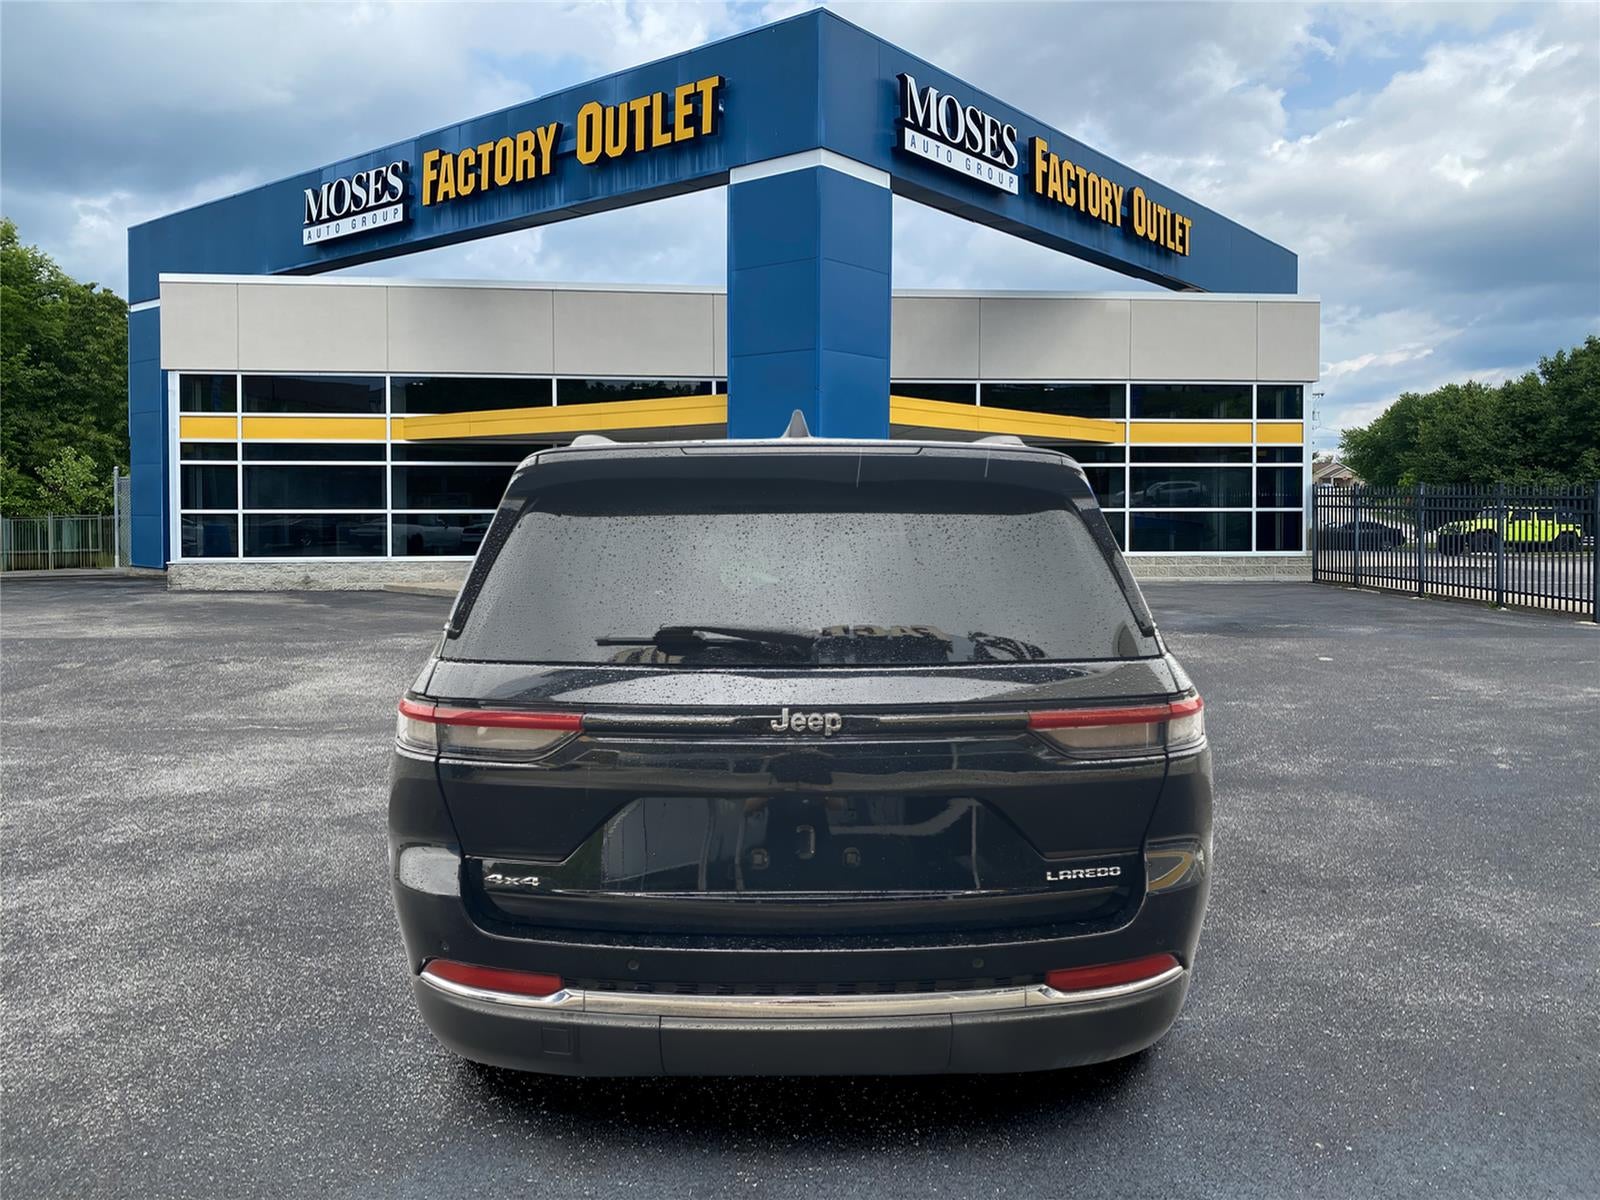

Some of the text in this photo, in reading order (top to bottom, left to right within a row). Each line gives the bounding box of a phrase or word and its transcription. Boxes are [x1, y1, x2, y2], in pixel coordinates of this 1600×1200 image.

[422, 75, 721, 207] FACTORY OUTLET
[904, 73, 1019, 169] MOSES
[910, 134, 1015, 188] AUTO GROUP
[303, 160, 405, 226] MOSES
[1034, 136, 1192, 257] FACTORY OUTLET
[307, 208, 400, 241] AUTO GROUP
[770, 707, 842, 737] Jeep
[1046, 866, 1121, 881] LAREDO
